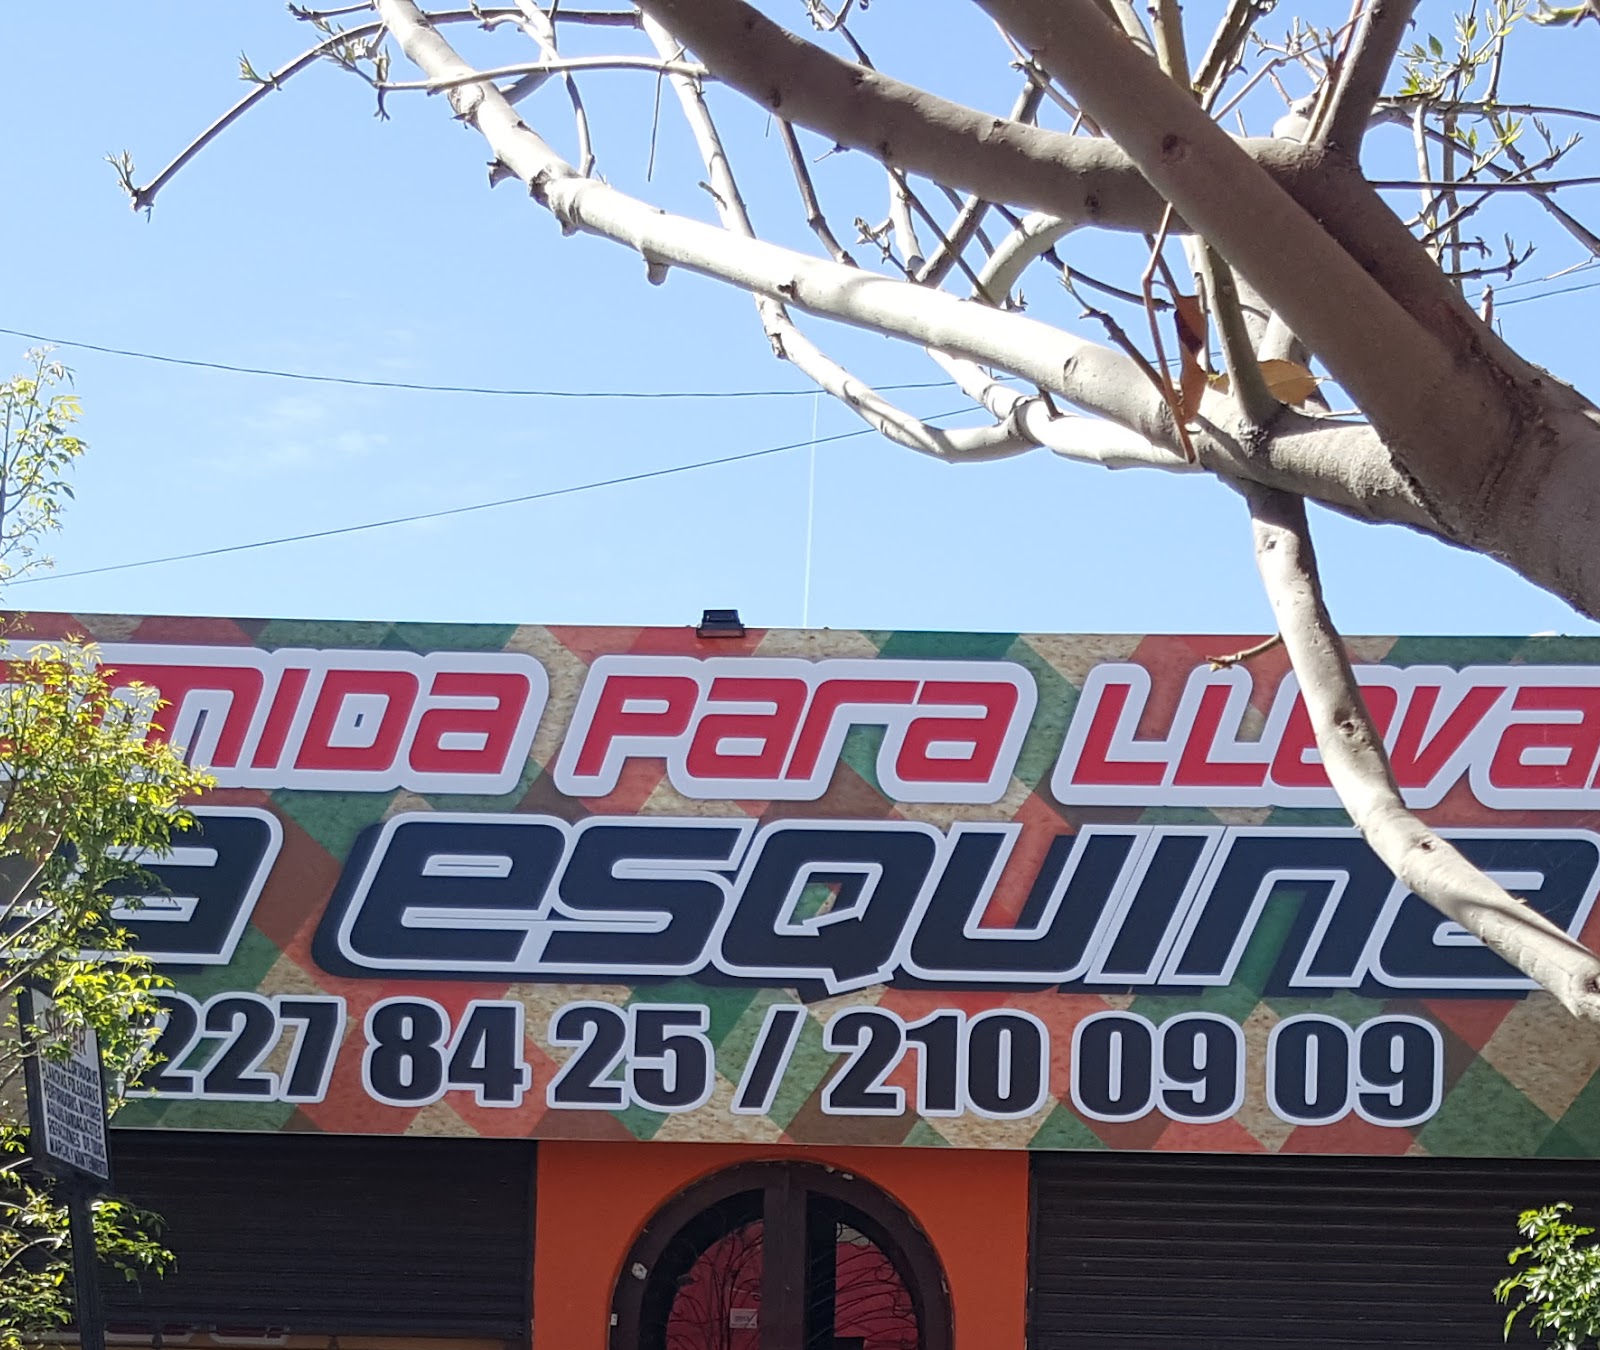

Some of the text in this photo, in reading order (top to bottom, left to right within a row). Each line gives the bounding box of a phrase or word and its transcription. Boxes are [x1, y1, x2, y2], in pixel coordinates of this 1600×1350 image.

[362, 995, 532, 1108] 84
[547, 1000, 716, 1112] 25
[820, 1005, 1050, 1119] 210
[1070, 1009, 1246, 1124] 09
[1266, 1013, 1443, 1128] 09
